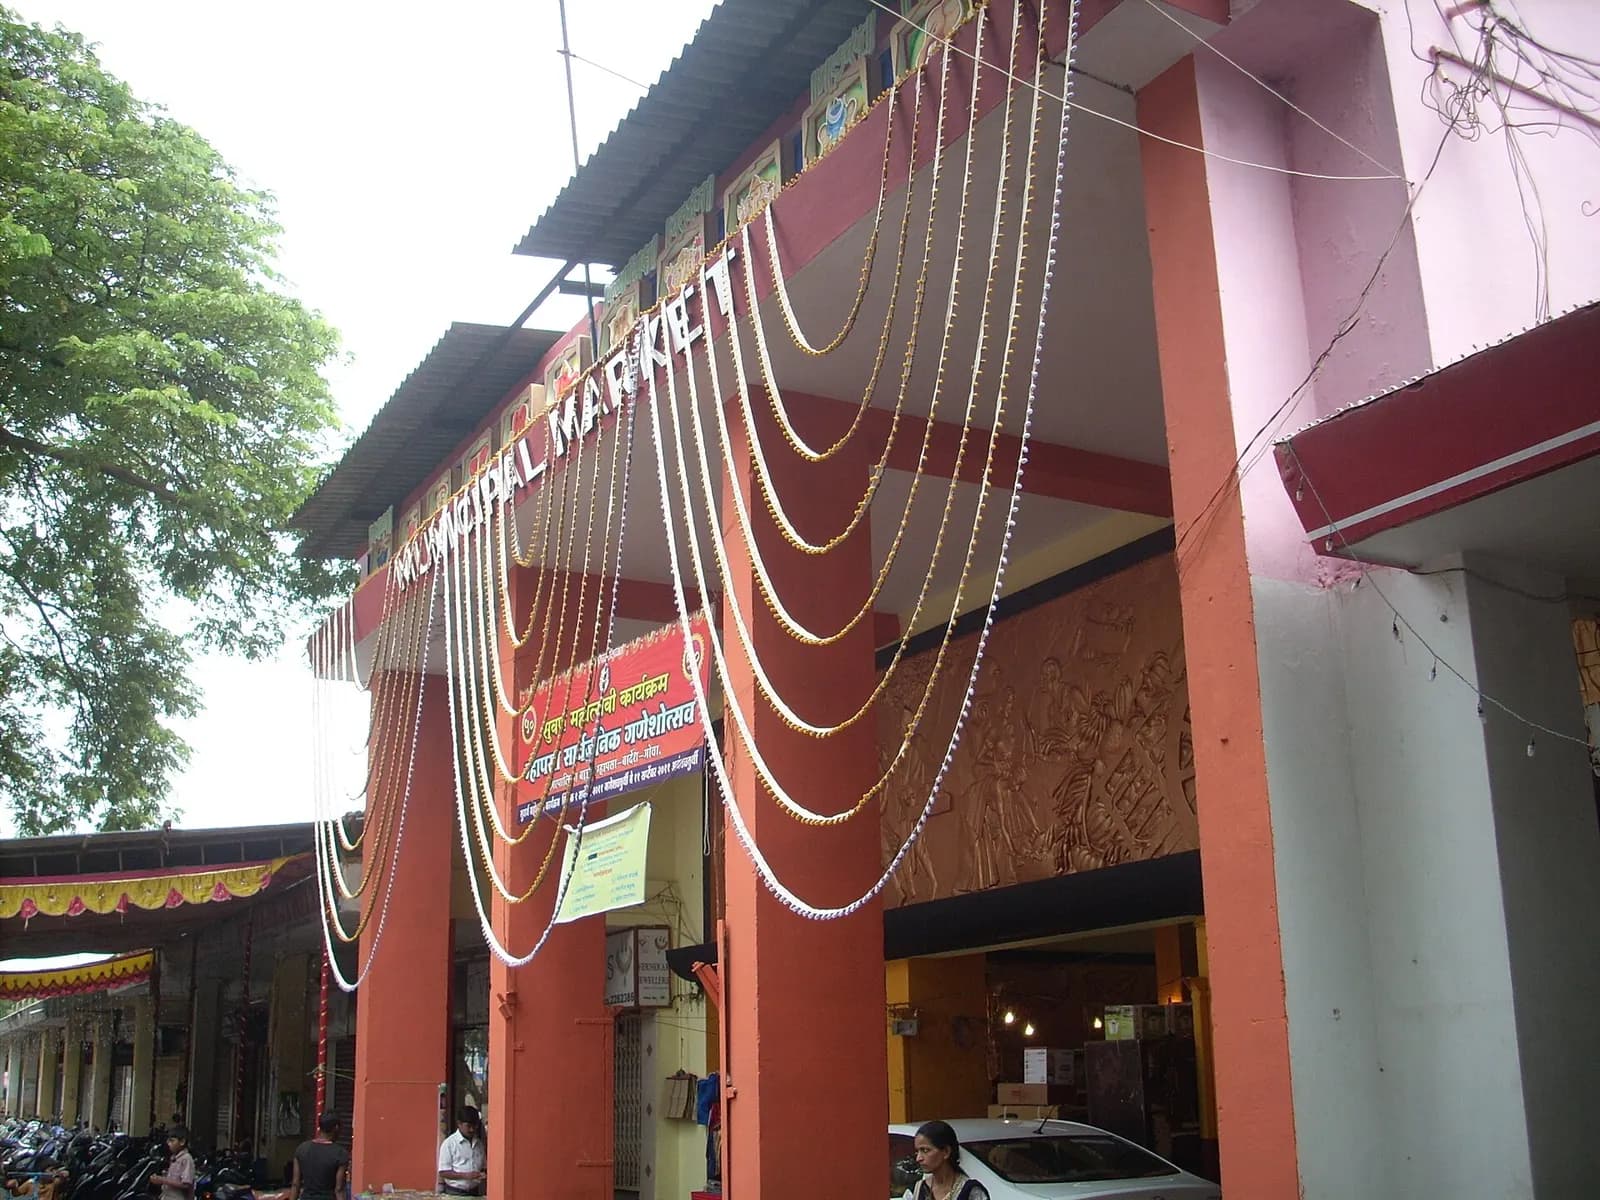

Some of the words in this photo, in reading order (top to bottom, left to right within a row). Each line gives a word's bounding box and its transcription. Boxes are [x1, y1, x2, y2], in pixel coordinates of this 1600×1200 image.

[550, 248, 736, 458] MARKET
[620, 673, 670, 707] कार्यक्रम
[624, 702, 697, 744] गणेशोत्सव
